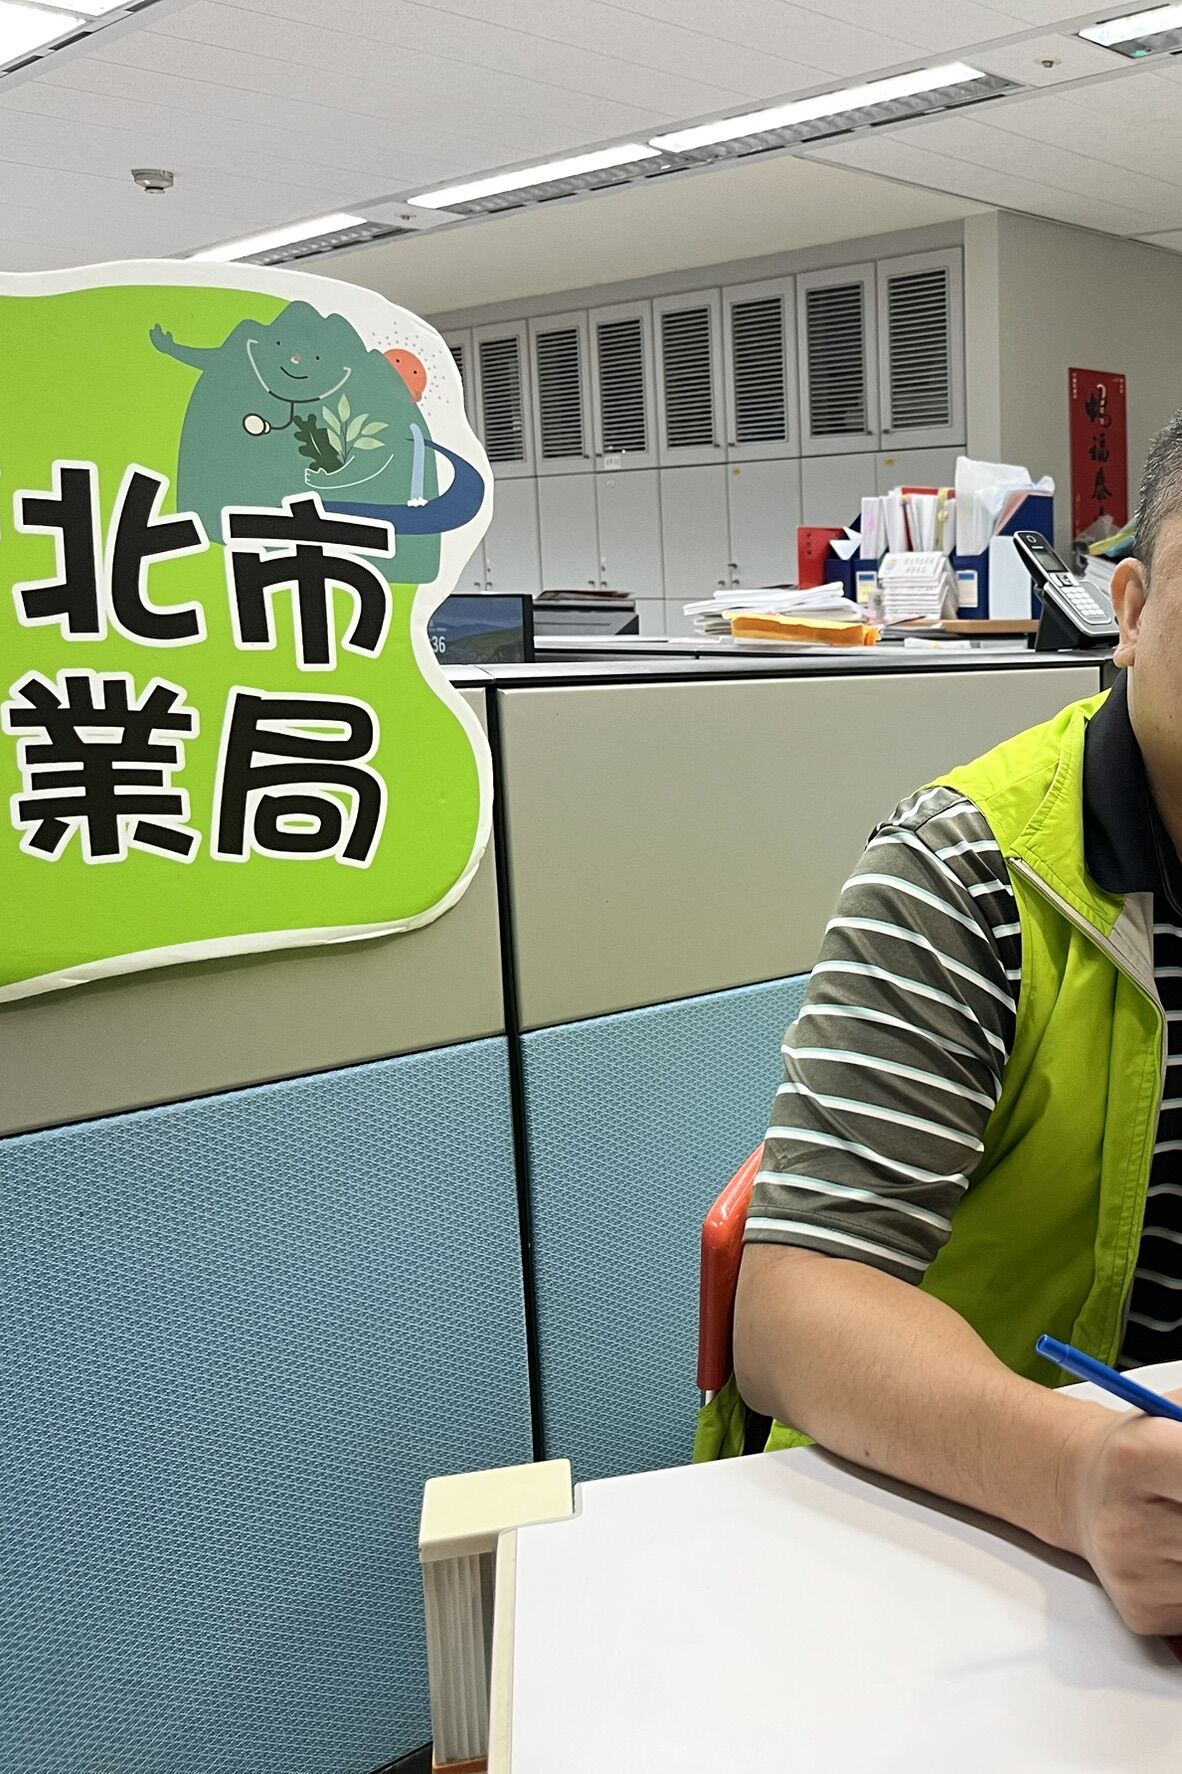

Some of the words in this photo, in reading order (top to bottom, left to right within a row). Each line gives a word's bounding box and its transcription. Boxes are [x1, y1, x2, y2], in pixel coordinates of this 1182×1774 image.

[20, 467, 390, 665] 北市
[431, 635, 446, 653] 36
[9, 674, 382, 863] 業局
